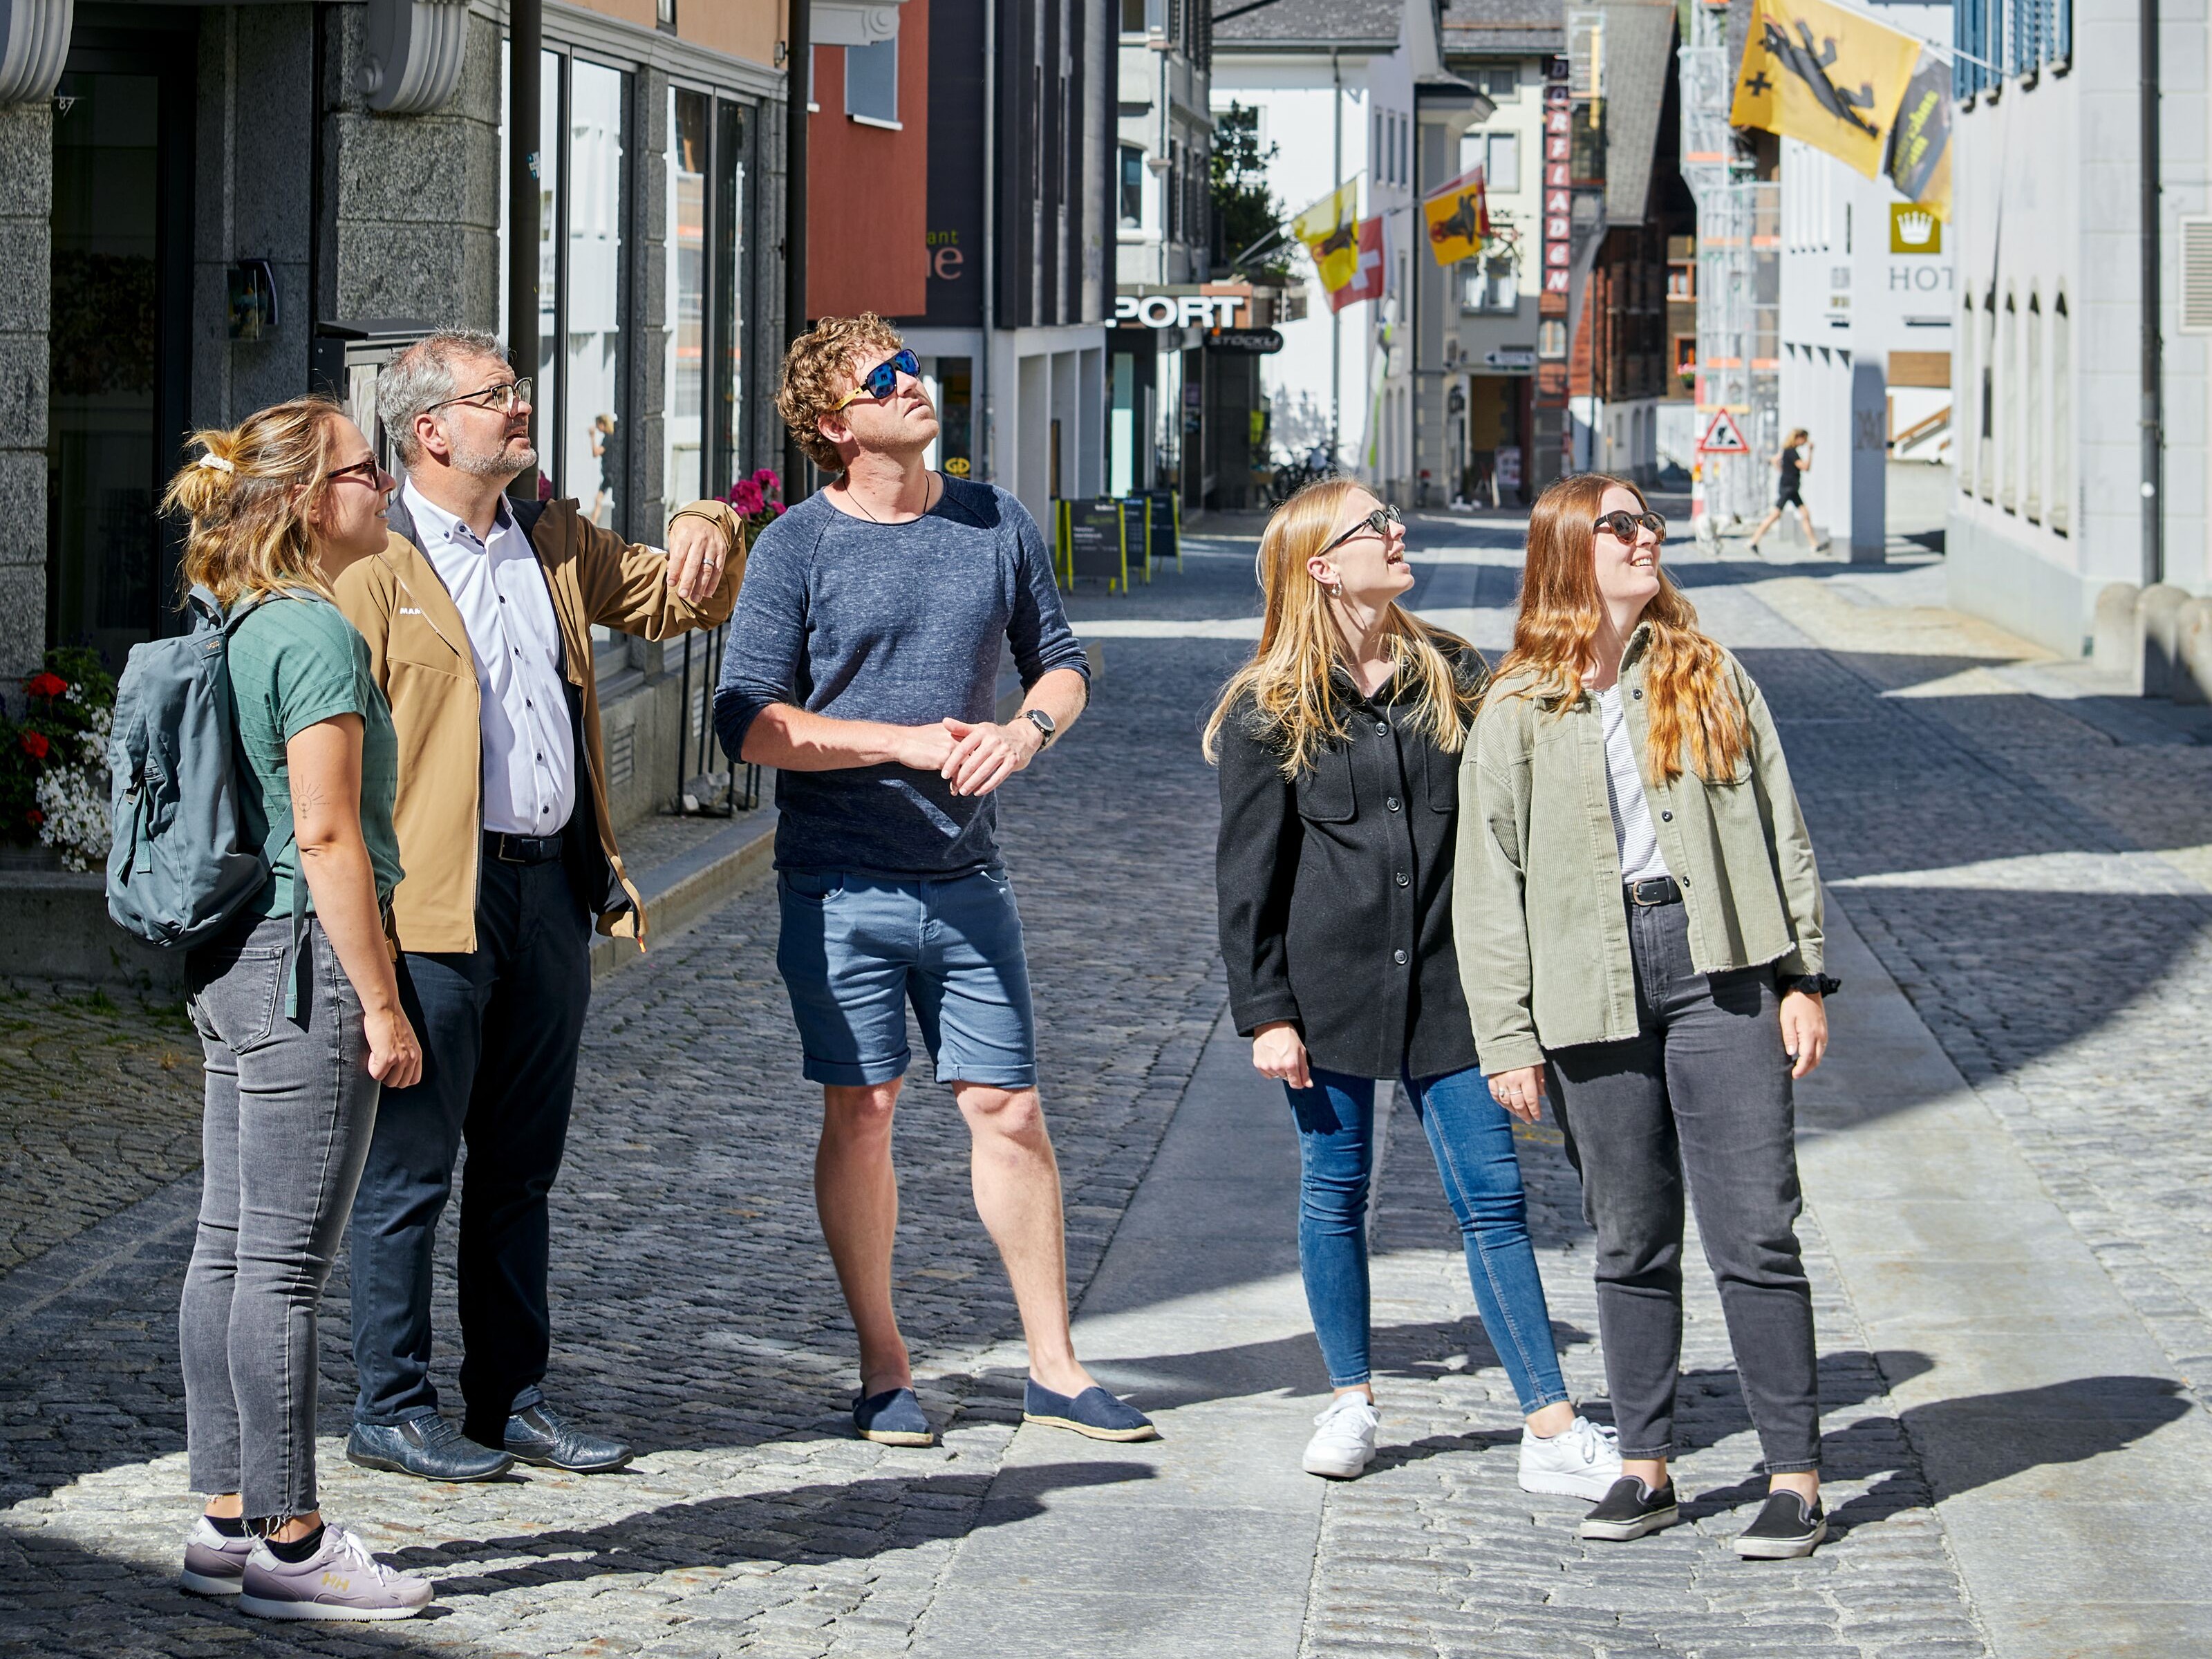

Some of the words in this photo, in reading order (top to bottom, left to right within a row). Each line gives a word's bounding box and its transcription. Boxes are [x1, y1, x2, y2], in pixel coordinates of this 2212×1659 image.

[927, 229, 959, 245] ant
[926, 247, 964, 280] e
[322, 1571, 350, 1592] HH
